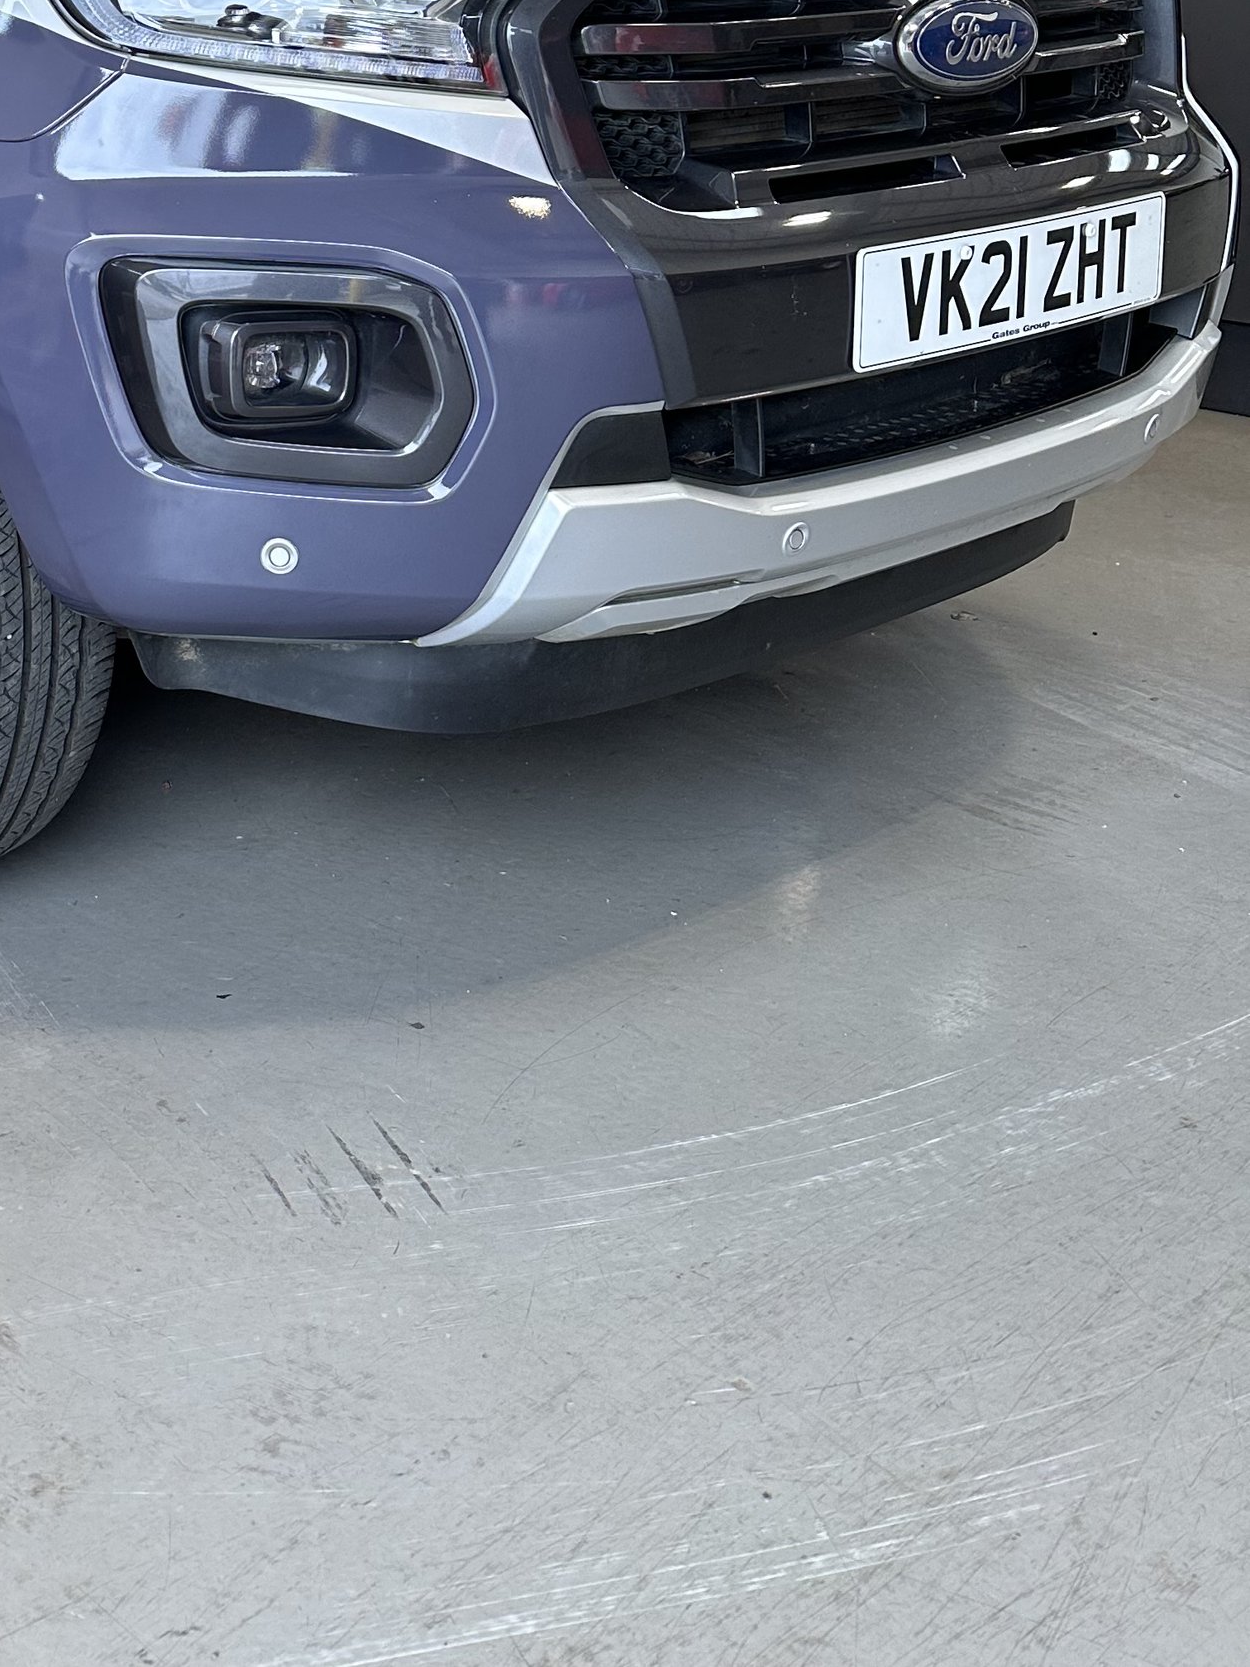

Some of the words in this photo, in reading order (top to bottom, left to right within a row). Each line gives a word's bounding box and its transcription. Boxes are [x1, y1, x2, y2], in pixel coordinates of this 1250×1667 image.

[946, 11, 1018, 66] Ford
[900, 235, 1029, 342] VK21
[1043, 211, 1137, 313] ZHT
[991, 326, 1020, 341] Gates
[1022, 320, 1051, 334] Group
